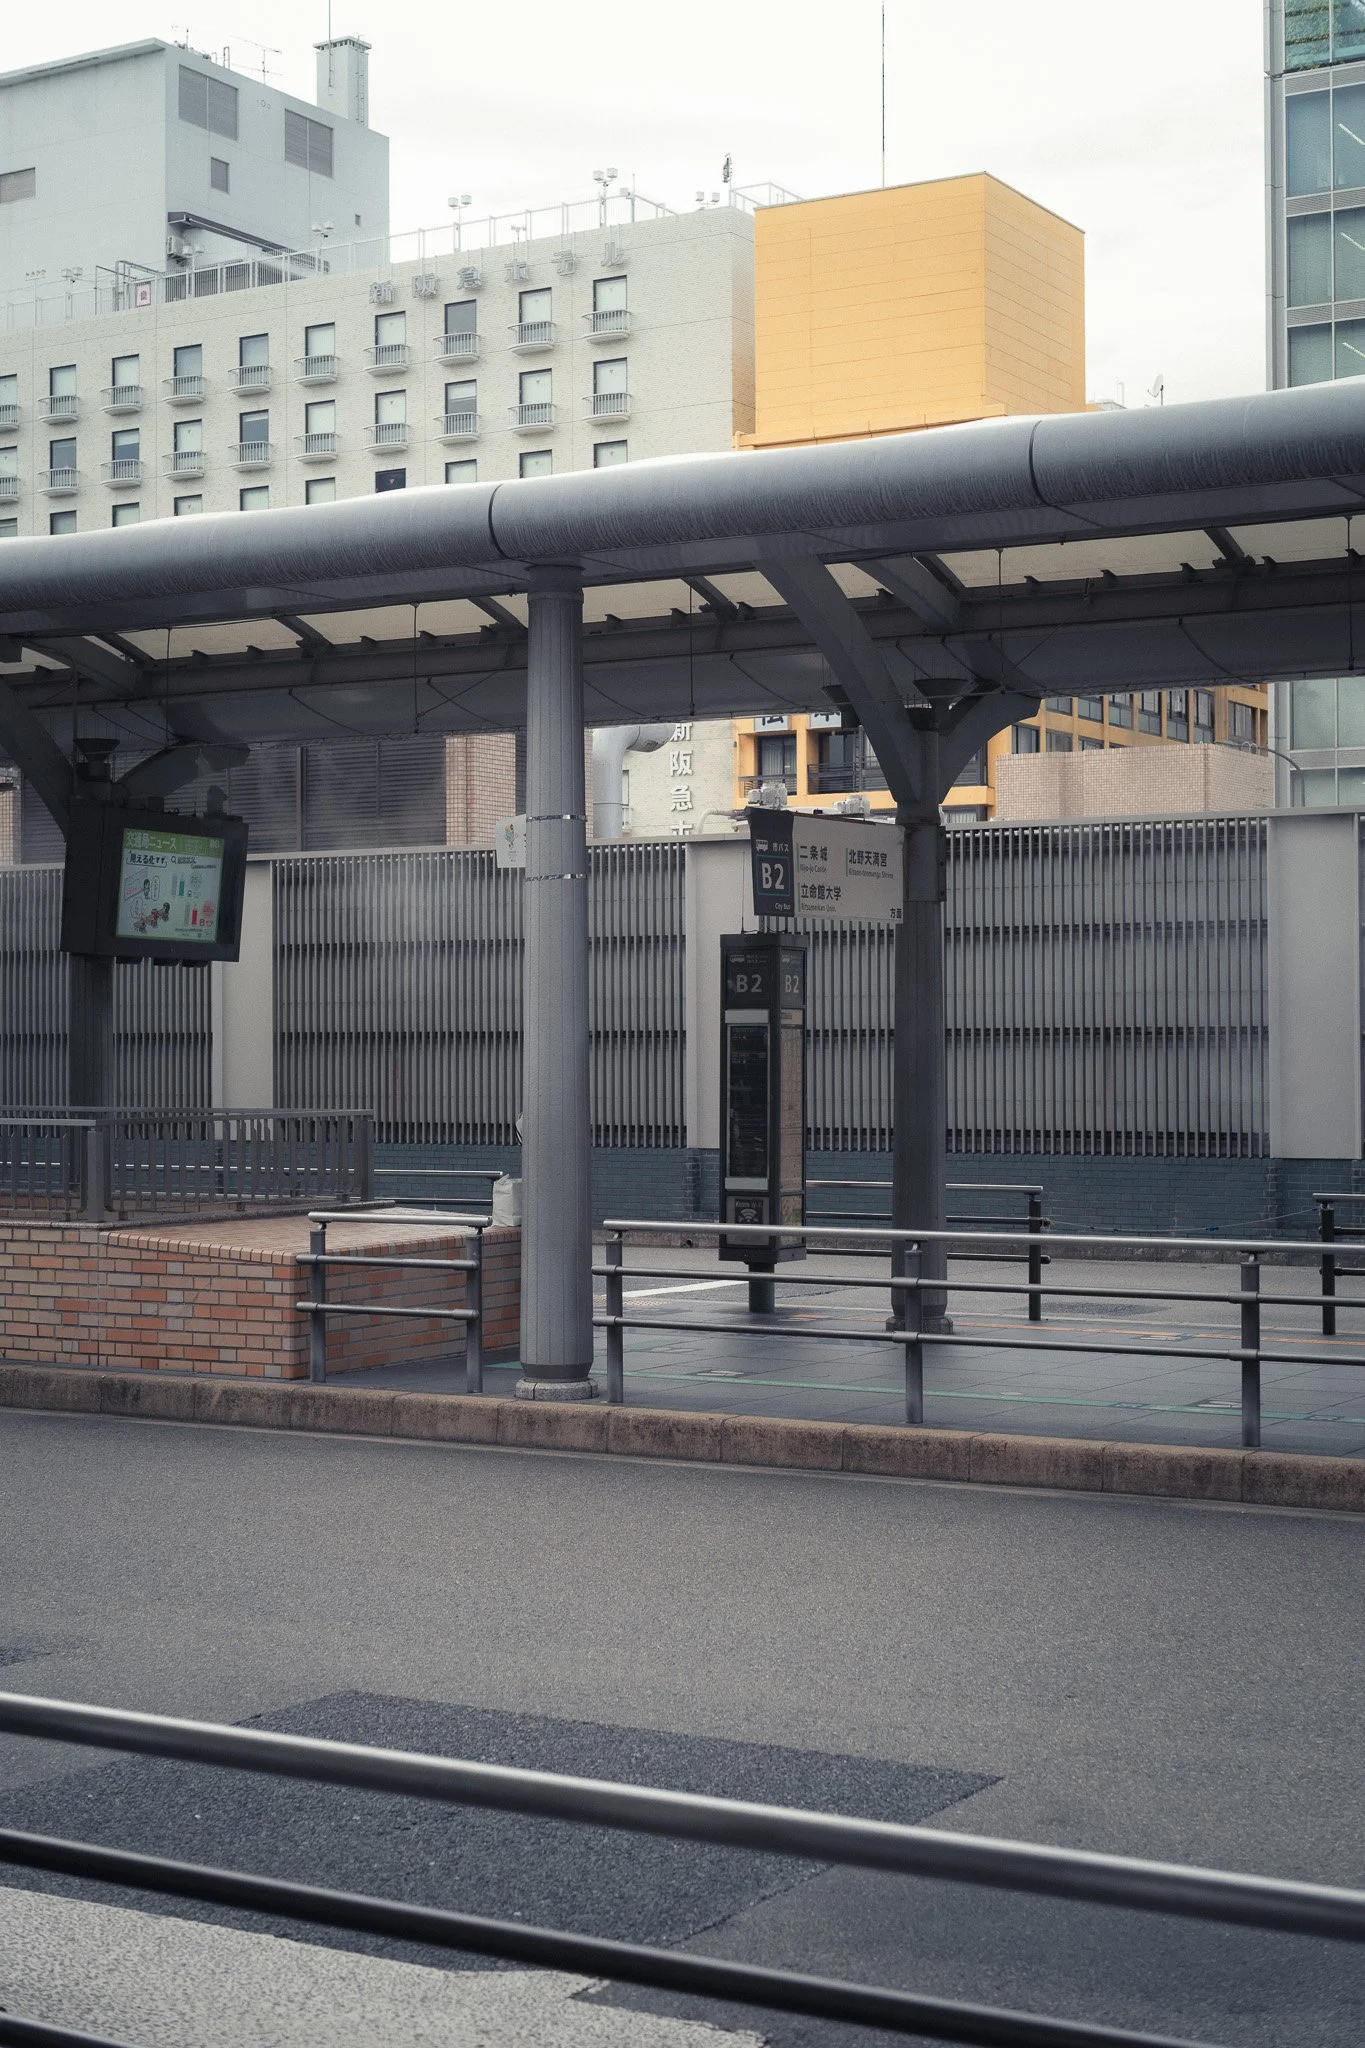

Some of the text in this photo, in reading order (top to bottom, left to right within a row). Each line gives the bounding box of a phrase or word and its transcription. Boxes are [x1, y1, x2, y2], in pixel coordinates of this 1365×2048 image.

[369, 242, 626, 304] 新阪急ホテル
[772, 842, 790, 853] 市バス
[799, 845, 828, 861] 二条城
[848, 849, 888, 868] 北野天満宮
[761, 862, 785, 890] B2
[801, 883, 842, 901] 立命館大学
[774, 903, 784, 912] City
[890, 908, 902, 919] 方面
[736, 974, 763, 993] B2
[785, 974, 799, 993] B2
